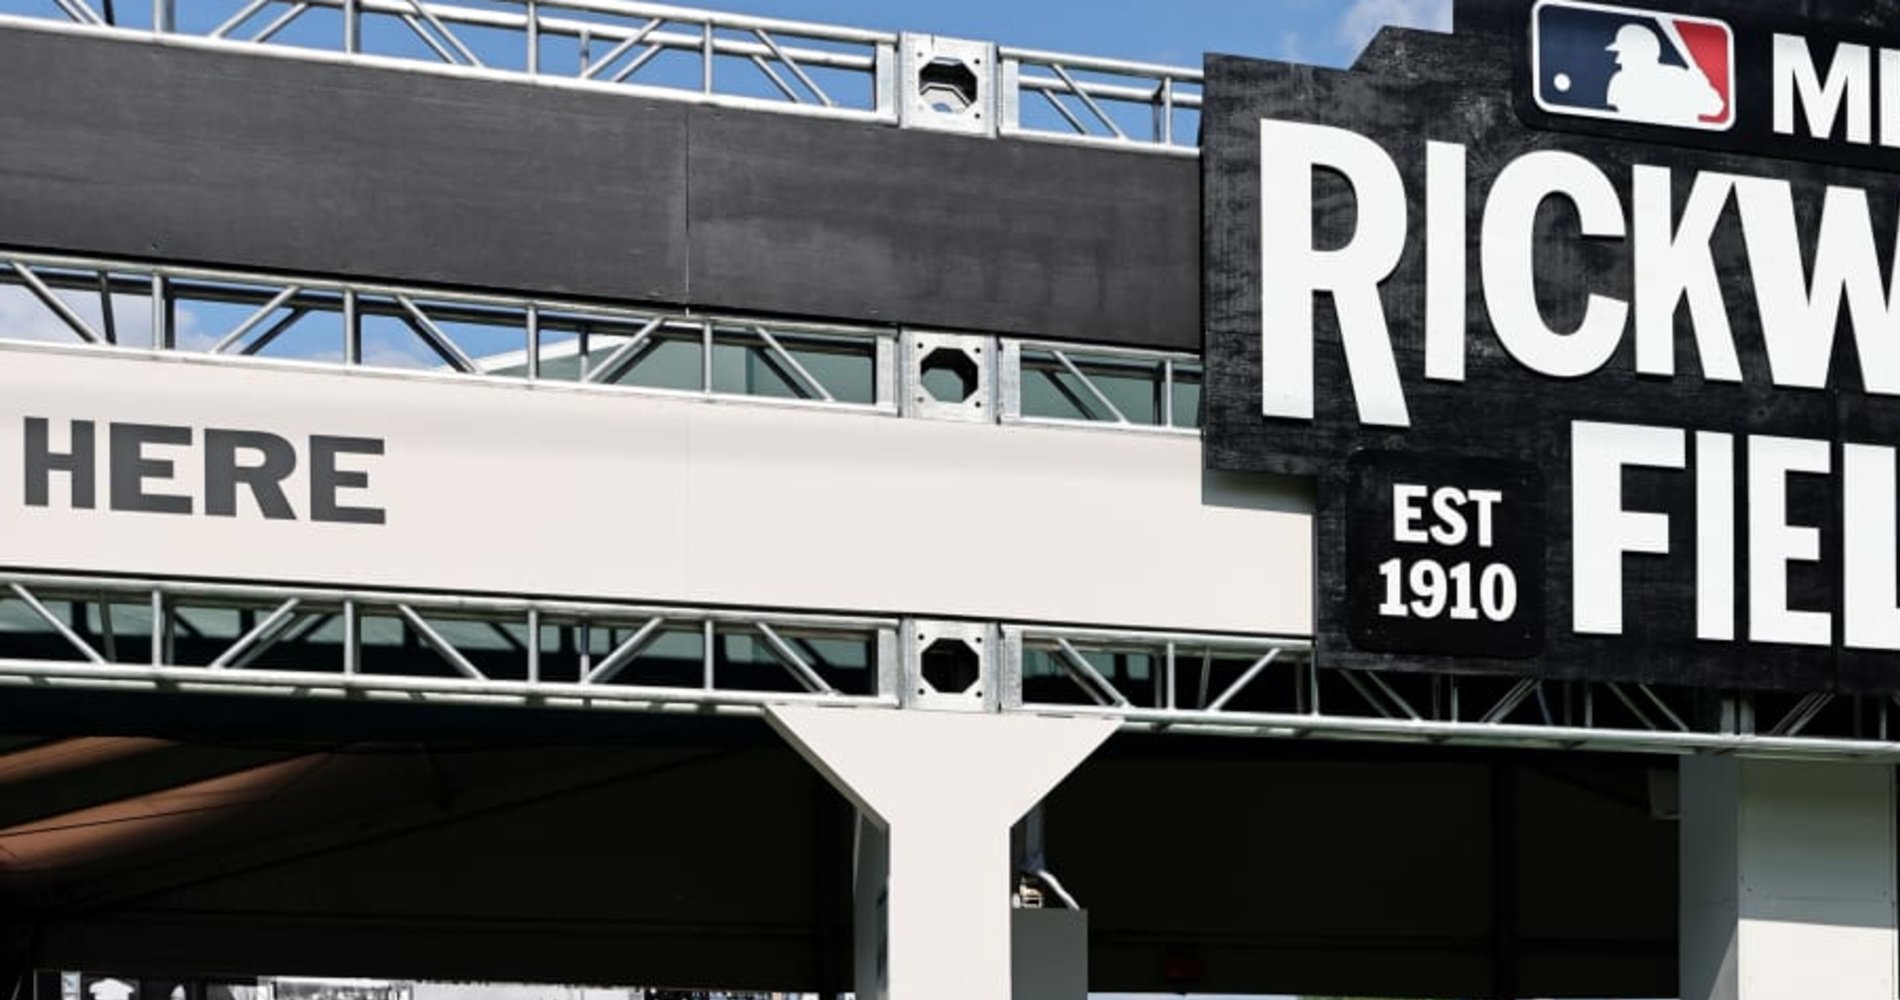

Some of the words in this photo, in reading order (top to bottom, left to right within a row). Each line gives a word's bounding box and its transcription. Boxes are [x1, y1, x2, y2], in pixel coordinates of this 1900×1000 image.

[23, 415, 386, 526] HERE
[1393, 483, 1502, 548] EST
[1379, 557, 1517, 622] 1910
